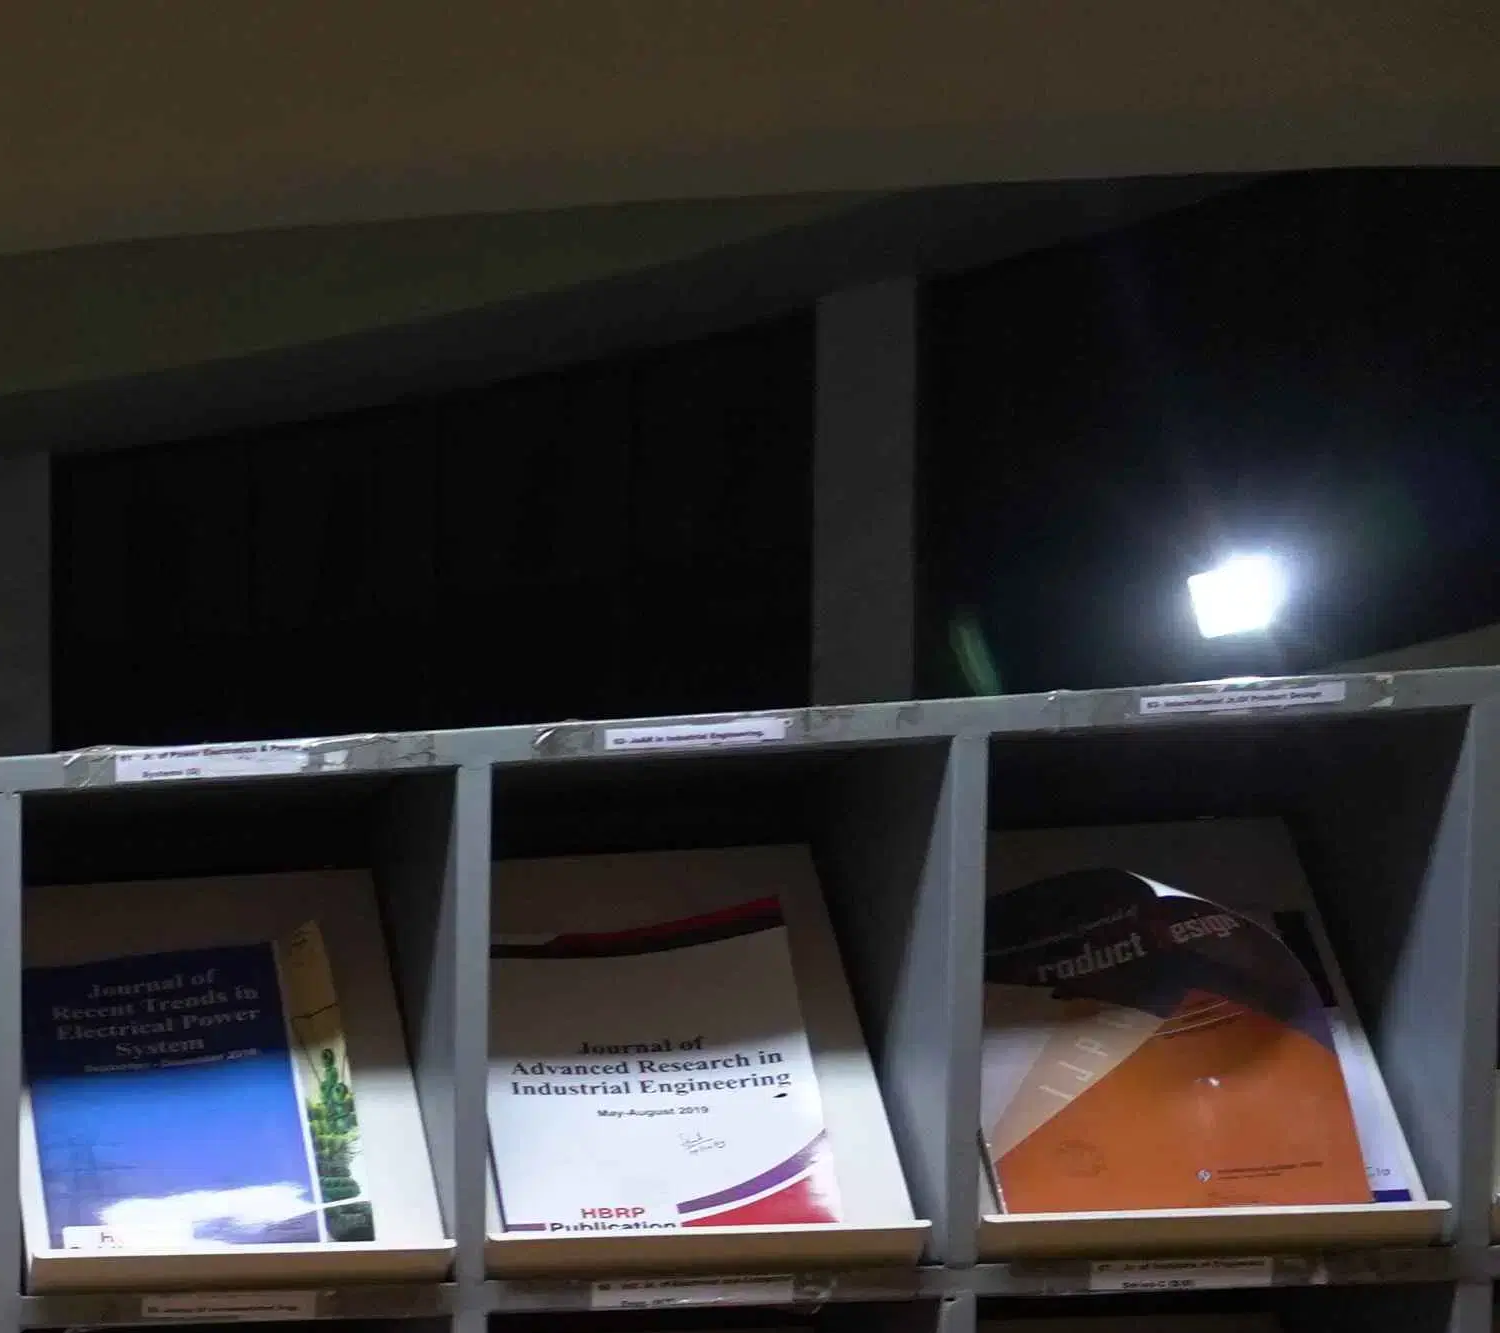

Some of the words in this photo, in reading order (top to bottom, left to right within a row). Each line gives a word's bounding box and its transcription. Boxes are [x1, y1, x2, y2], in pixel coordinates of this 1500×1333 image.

[86, 972, 184, 1000] Journal
[190, 967, 218, 986] of
[51, 997, 136, 1021] Recent
[139, 988, 229, 1013] Trends
[235, 984, 260, 1001] in
[56, 1014, 175, 1041] Electrical
[181, 1006, 261, 1027] Power
[115, 1034, 206, 1060] System
[511, 1059, 629, 1077] Advanced
[638, 1055, 745, 1075] Research
[750, 1049, 784, 1067] in
[511, 1079, 630, 1097] Industrial
[640, 1070, 793, 1096] Engineering
[678, 1105, 710, 1116] 2019
[579, 1206, 646, 1220] HBRP
